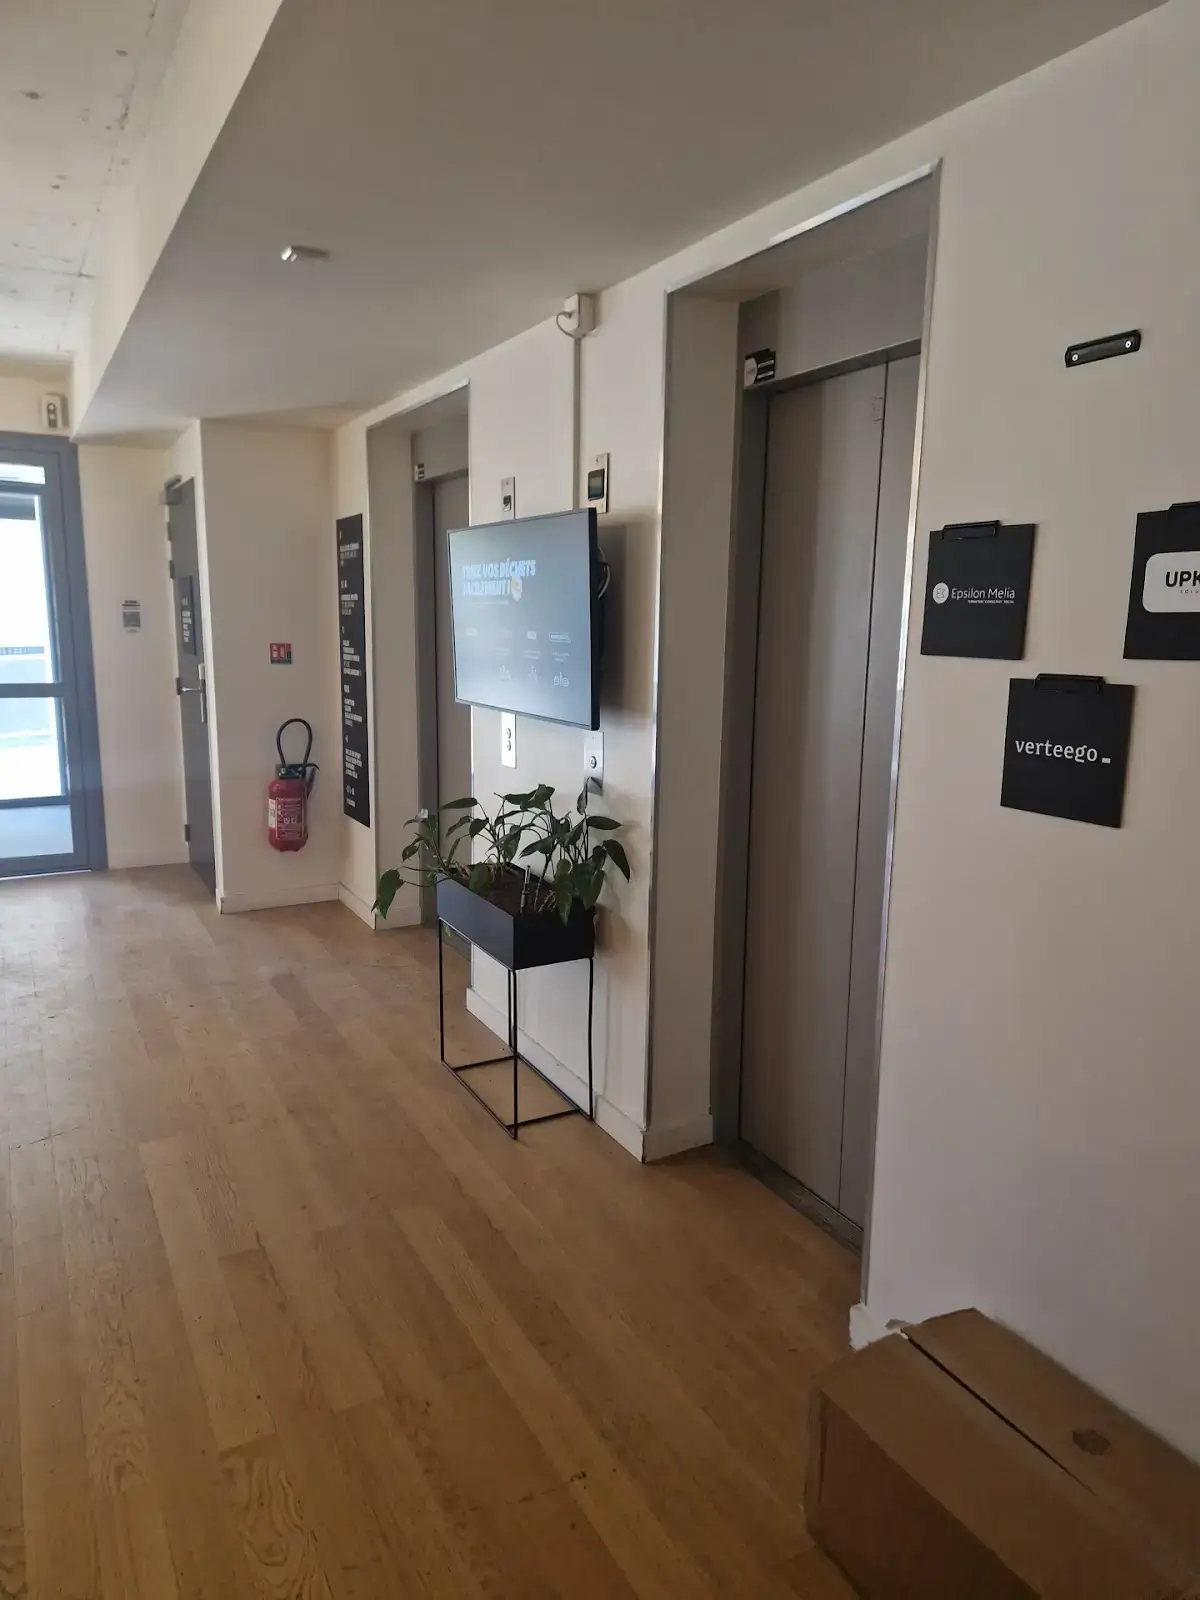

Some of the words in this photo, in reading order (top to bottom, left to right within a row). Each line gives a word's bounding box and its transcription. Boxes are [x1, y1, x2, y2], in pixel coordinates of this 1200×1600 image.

[483, 563, 499, 578] VOS
[951, 587, 986, 600] Epsilon
[988, 587, 1015, 599] Melia
